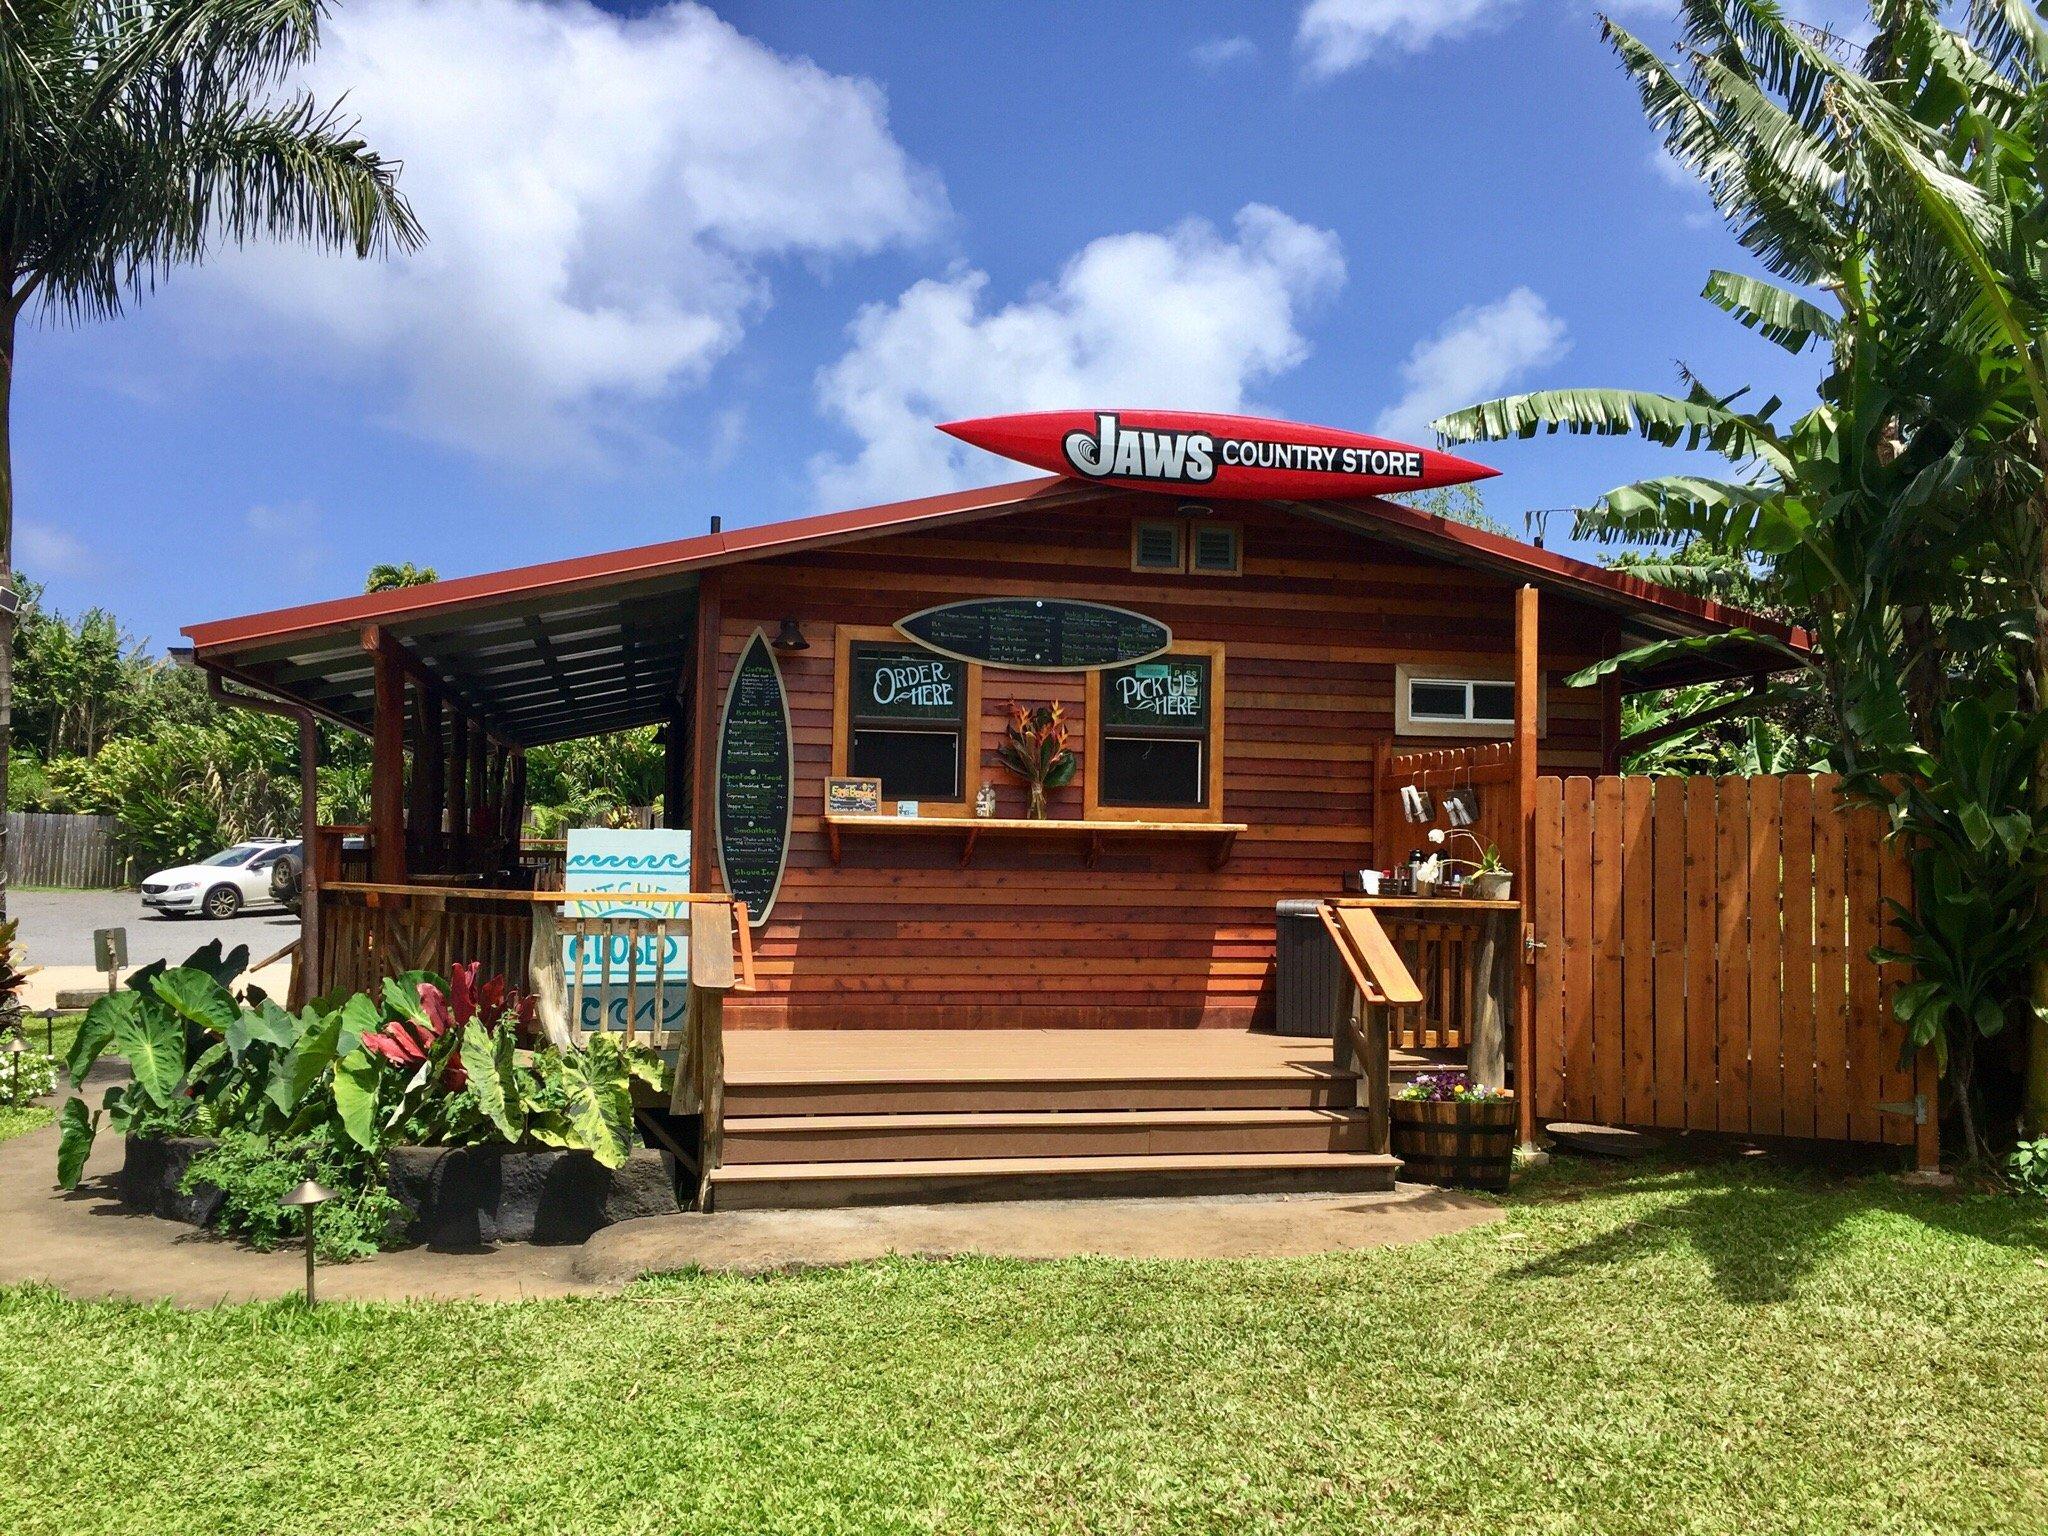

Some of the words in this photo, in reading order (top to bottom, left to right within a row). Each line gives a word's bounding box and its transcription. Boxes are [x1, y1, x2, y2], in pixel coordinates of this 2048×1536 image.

[1065, 415, 1213, 481] JAWS
[1223, 440, 1336, 472] COUNTRY
[1342, 448, 1420, 477] STORE
[873, 662, 951, 704] ORDER
[911, 683, 954, 705] HERE
[1116, 676, 1163, 704] PICK
[1167, 674, 1198, 696] UP
[1155, 695, 1198, 715] HERE
[577, 881, 684, 918] KITCHEN
